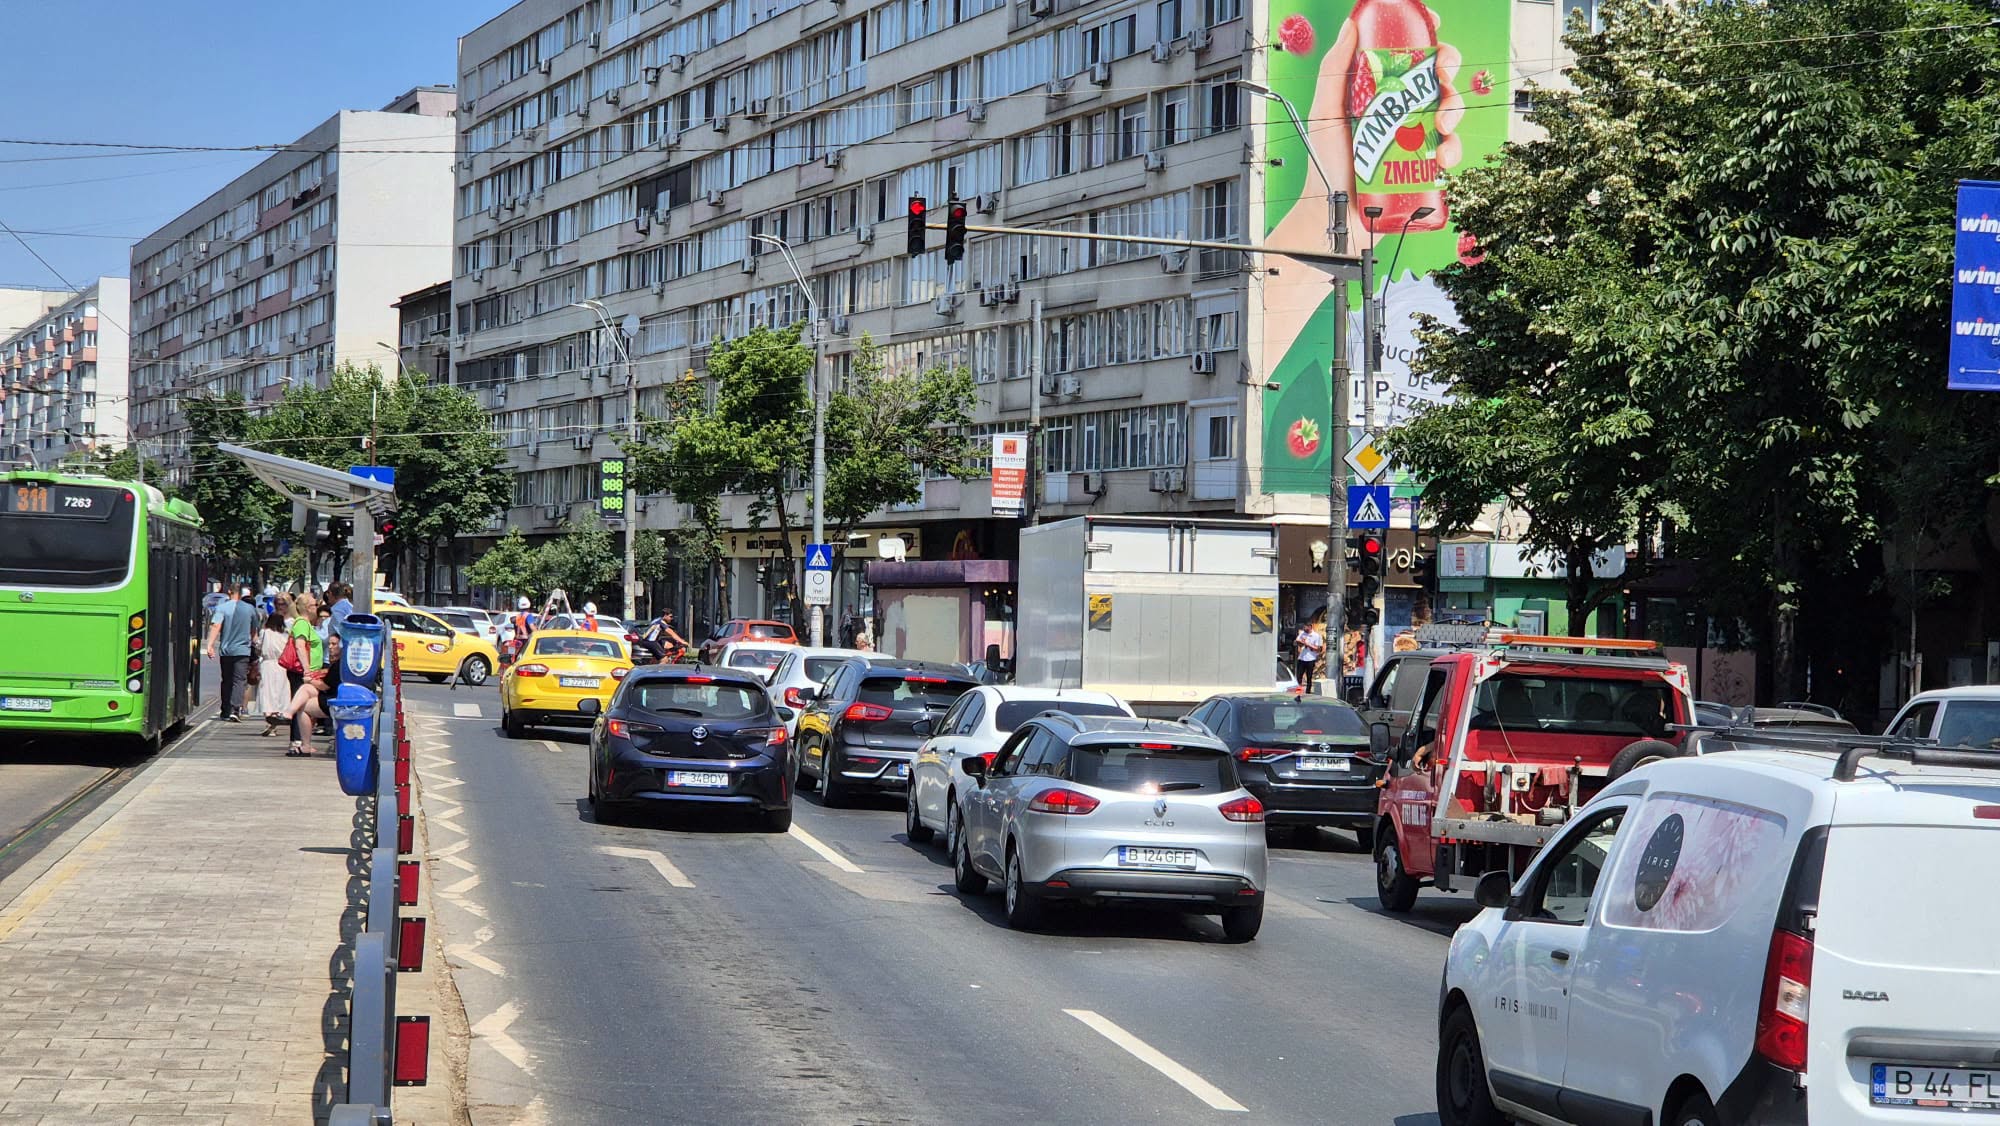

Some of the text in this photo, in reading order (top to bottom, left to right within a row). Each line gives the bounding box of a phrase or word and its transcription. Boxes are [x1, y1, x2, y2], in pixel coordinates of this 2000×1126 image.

[1408, 373, 1430, 391] DE
[602, 461, 624, 473] 888
[602, 479, 623, 491] 888
[17, 487, 48, 512] 311
[64, 497, 92, 508] 7263
[602, 497, 623, 509] 888
[1129, 848, 1138, 861] B
[1843, 989, 1889, 1001] DACIA
[1495, 996, 1519, 1013] IRIS
[1895, 1070, 1913, 1095] B
[1924, 1071, 1953, 1097] 44
